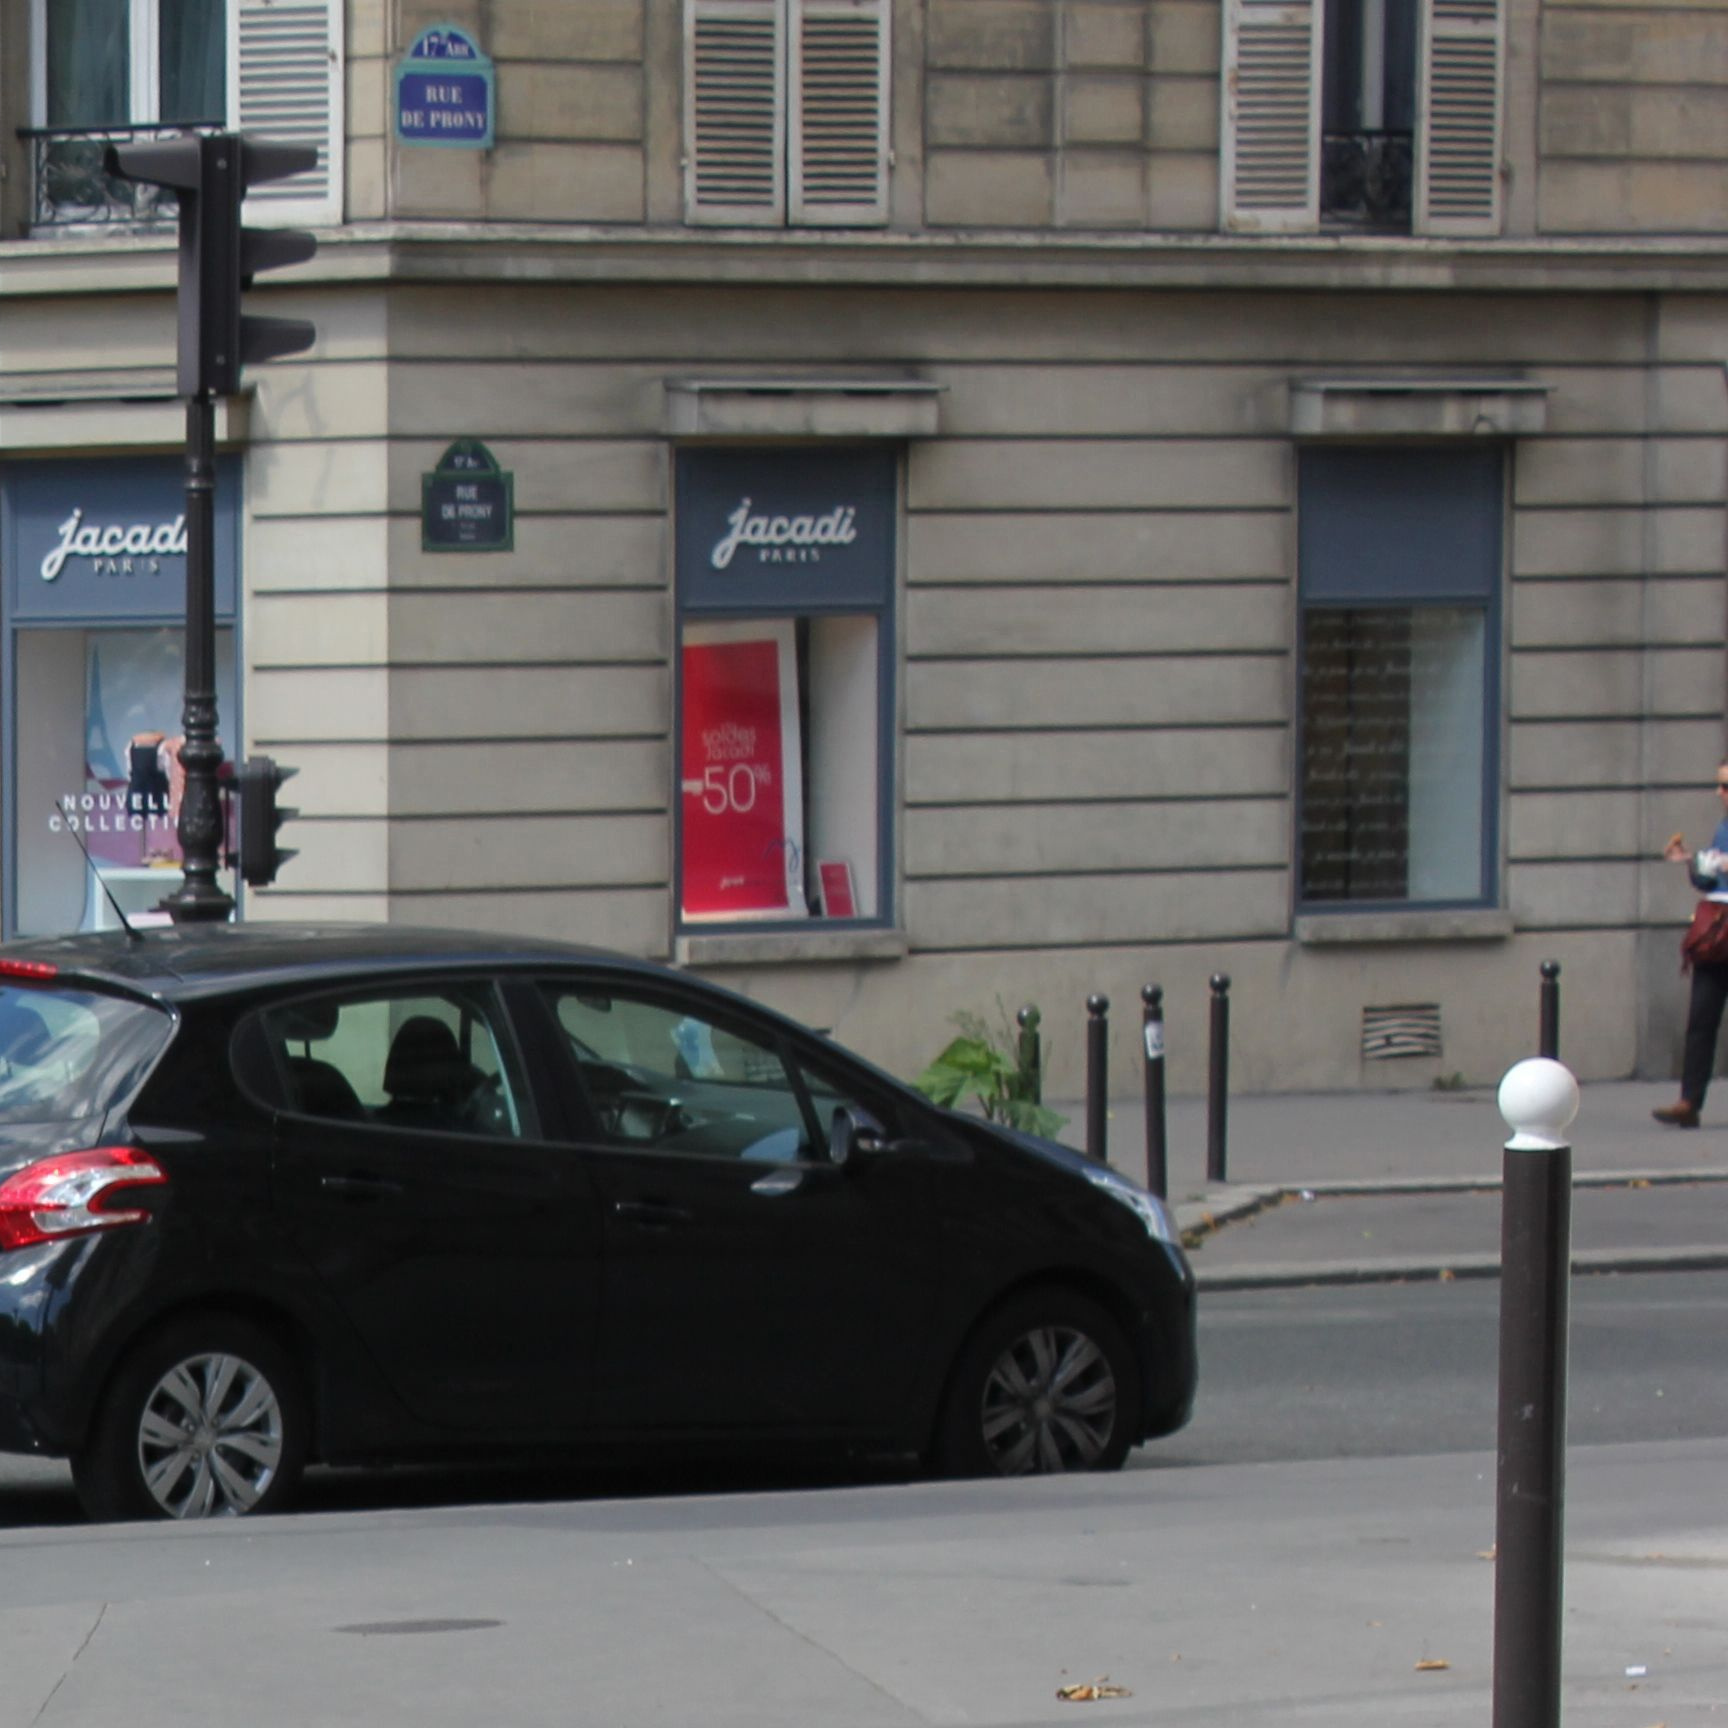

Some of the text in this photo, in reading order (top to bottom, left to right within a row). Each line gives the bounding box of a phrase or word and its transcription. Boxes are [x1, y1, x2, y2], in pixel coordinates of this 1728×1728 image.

[426, 85, 462, 104] RUE
[402, 110, 485, 129] DE PRONY
[711, 497, 857, 569] jacadi
[40, 507, 188, 581] jacad
[759, 548, 820, 563] PARIS
[93, 559, 159, 574] PARIS
